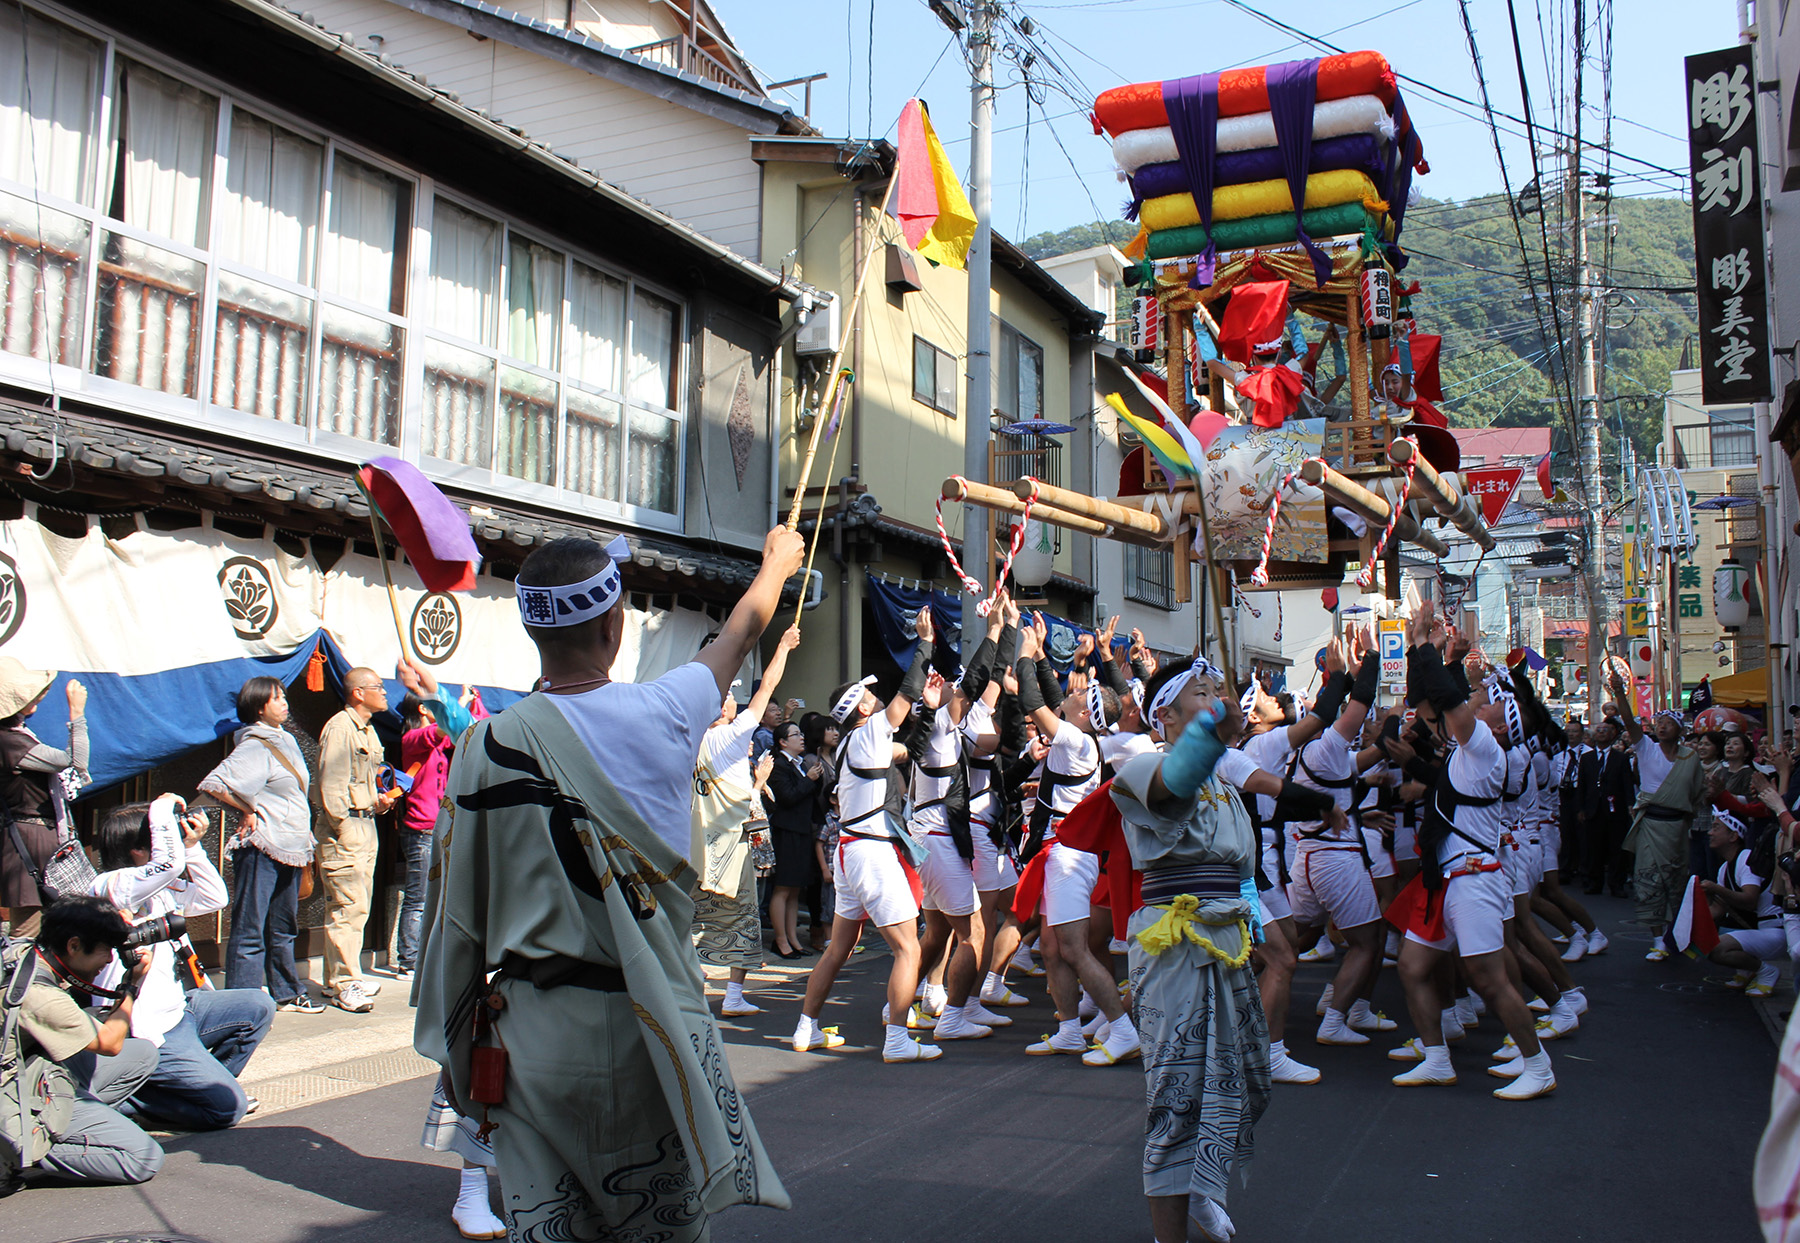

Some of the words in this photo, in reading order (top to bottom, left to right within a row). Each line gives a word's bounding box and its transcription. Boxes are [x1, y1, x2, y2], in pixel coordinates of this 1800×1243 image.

[1692, 64, 1752, 217] 彫刻
[1711, 248, 1757, 384] 彫美堂
[1471, 479, 1511, 494] 止まれ
[1384, 636, 1402, 657] P
